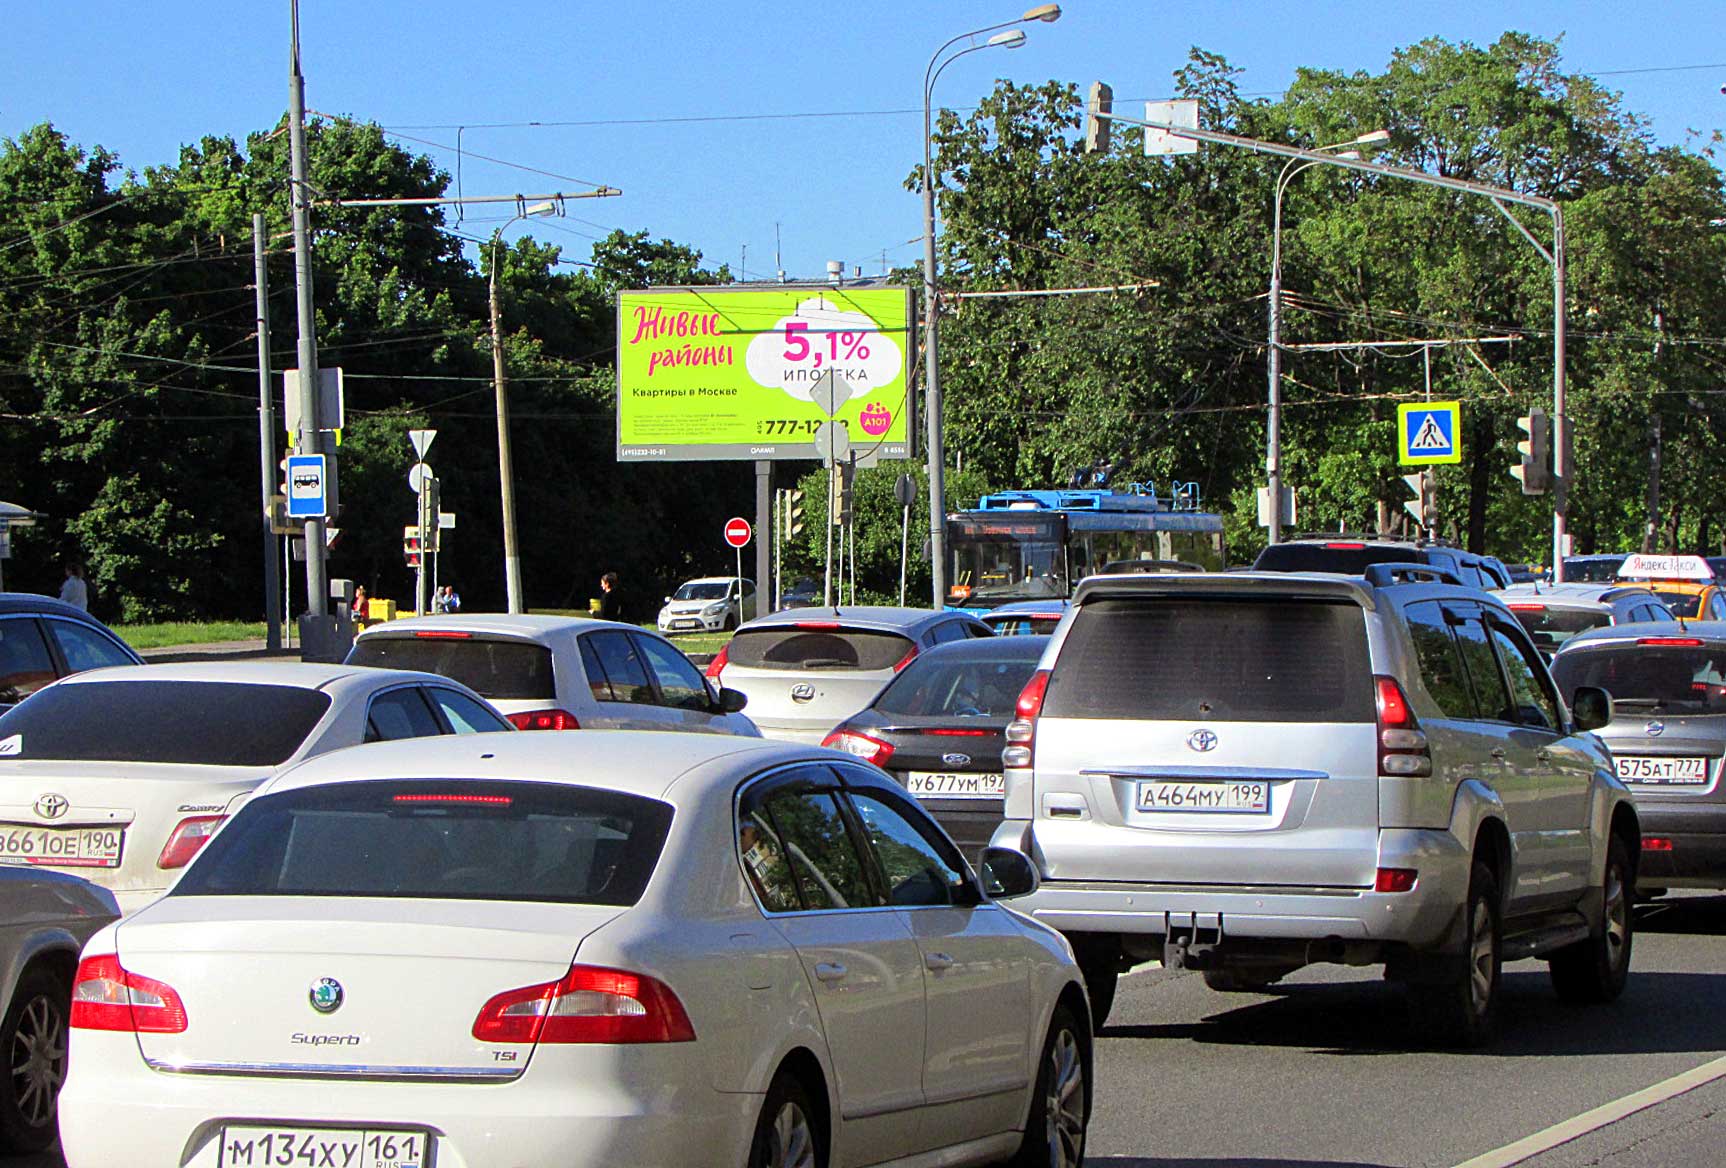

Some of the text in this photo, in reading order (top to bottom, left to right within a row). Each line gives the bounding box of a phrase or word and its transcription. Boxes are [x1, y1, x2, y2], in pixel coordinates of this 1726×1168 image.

[630, 306, 722, 344] Живые
[783, 323, 870, 368] 5,1%
[648, 344, 732, 376] районы
[632, 388, 686, 397] Квартиры
[698, 388, 737, 396] Москве
[1634, 557, 1697, 571] Яндекс Такси
[1616, 759, 1701, 777] 575АТ 777
[914, 775, 978, 791] У677УМ
[1144, 785, 1262, 806] А464МУ 199
[83, 832, 114, 849] 190
[291, 1033, 360, 1046] Superb
[492, 1051, 517, 1061] TSI
[231, 1133, 415, 1167] М134ХУ 161
